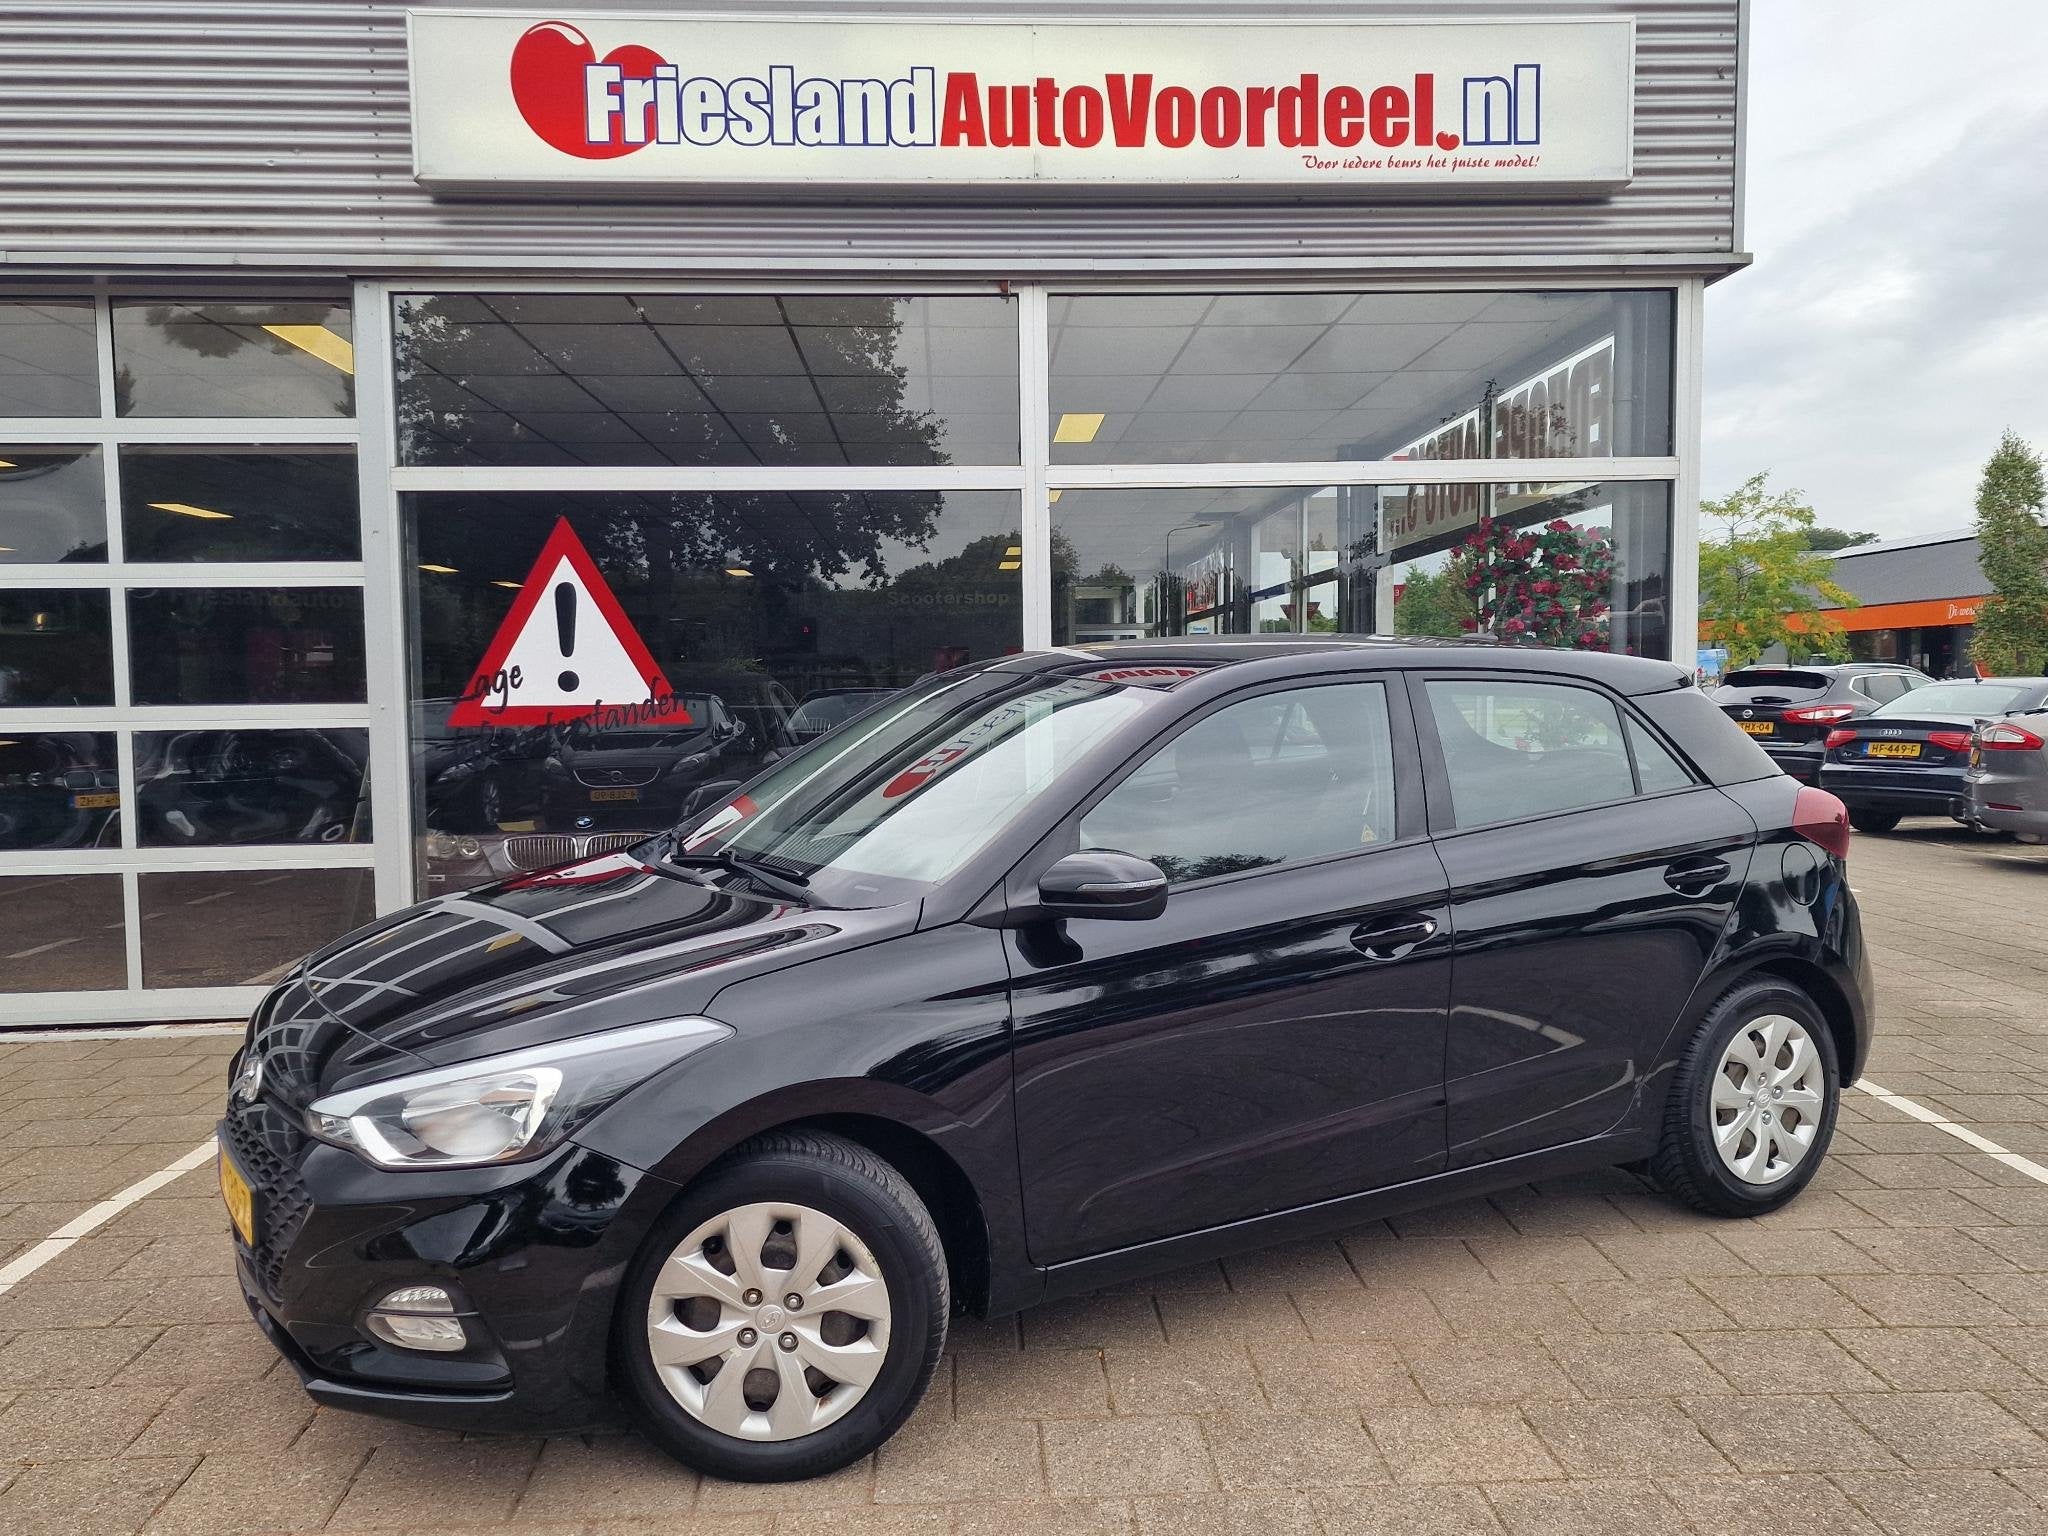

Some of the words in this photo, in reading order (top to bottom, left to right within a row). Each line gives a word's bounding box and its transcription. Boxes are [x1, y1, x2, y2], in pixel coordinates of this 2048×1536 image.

[1301, 154, 1339, 169] Voor
[1342, 155, 1382, 169] iedere
[1387, 155, 1422, 168] beurs
[1426, 154, 1448, 168] het
[1451, 156, 1491, 172] juiste
[1494, 153, 1540, 168] model!
[1871, 744, 1918, 755] HF-449-F
